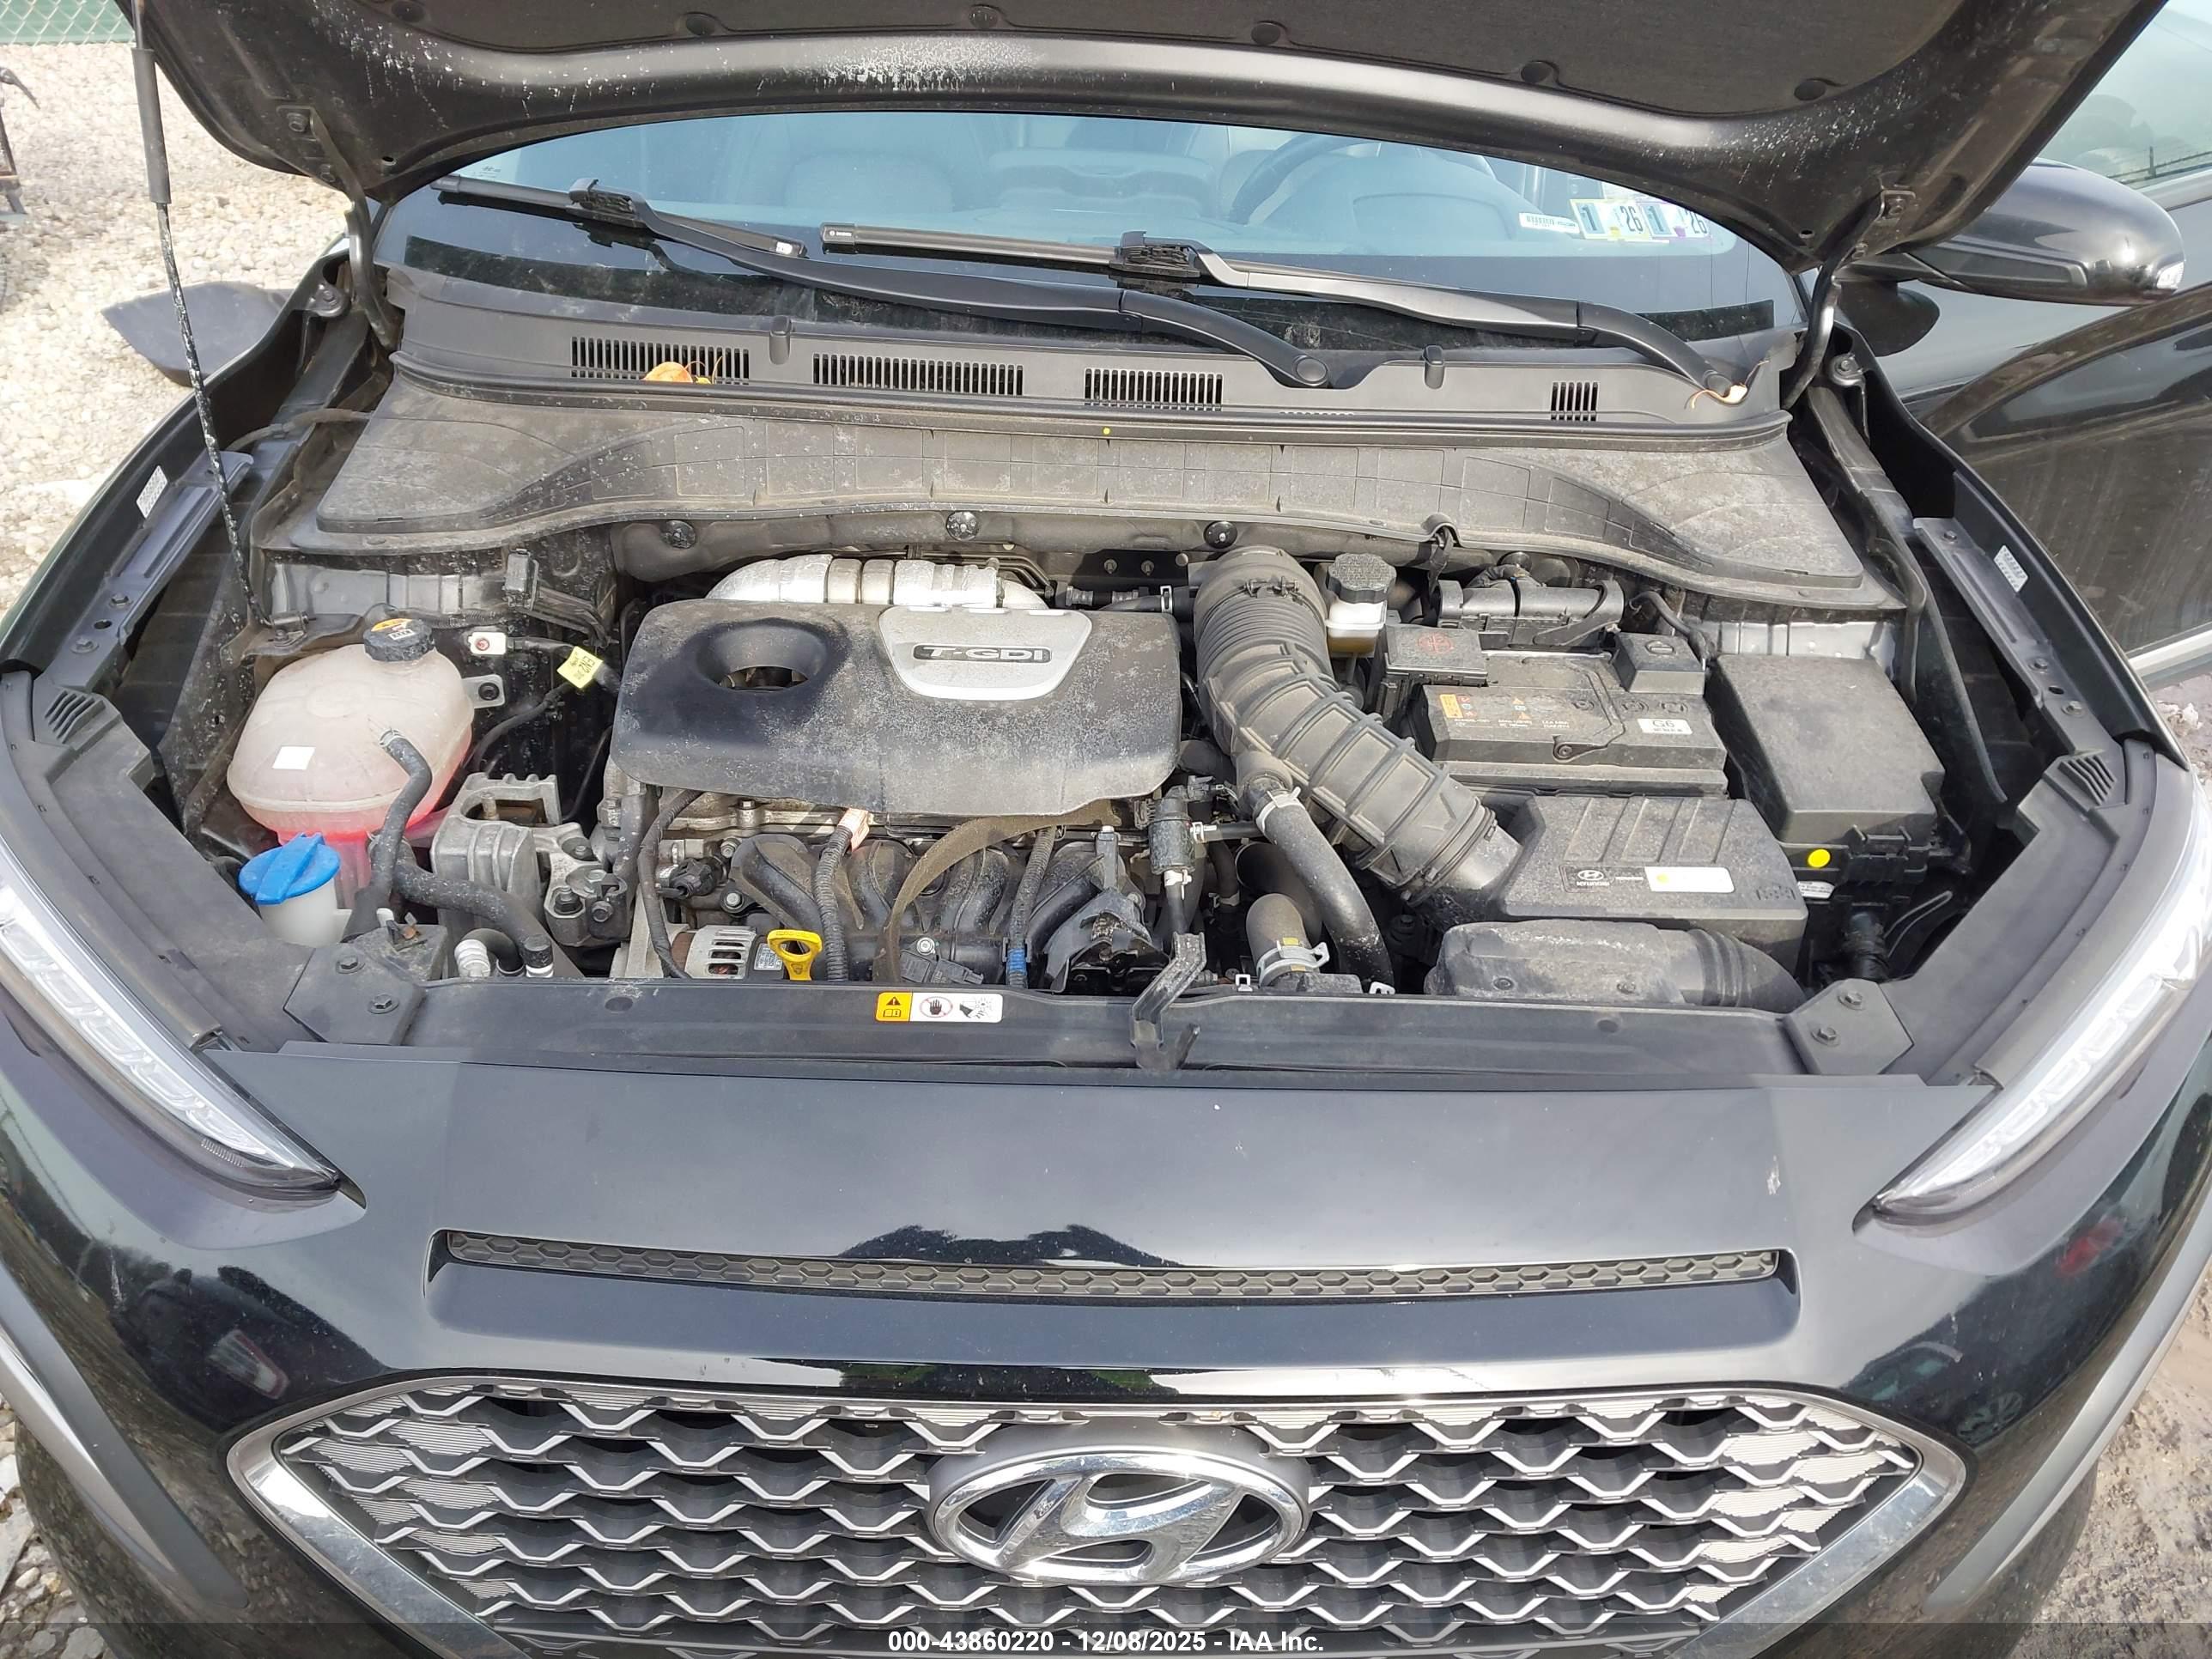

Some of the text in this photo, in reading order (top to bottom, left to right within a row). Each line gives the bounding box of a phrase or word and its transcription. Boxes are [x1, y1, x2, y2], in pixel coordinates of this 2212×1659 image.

[1580, 205, 1598, 231] 1
[1620, 205, 1644, 233] 26
[1648, 205, 1708, 234] 1 26
[922, 647, 1043, 660] T-GDI
[1652, 720, 1675, 728] G6
